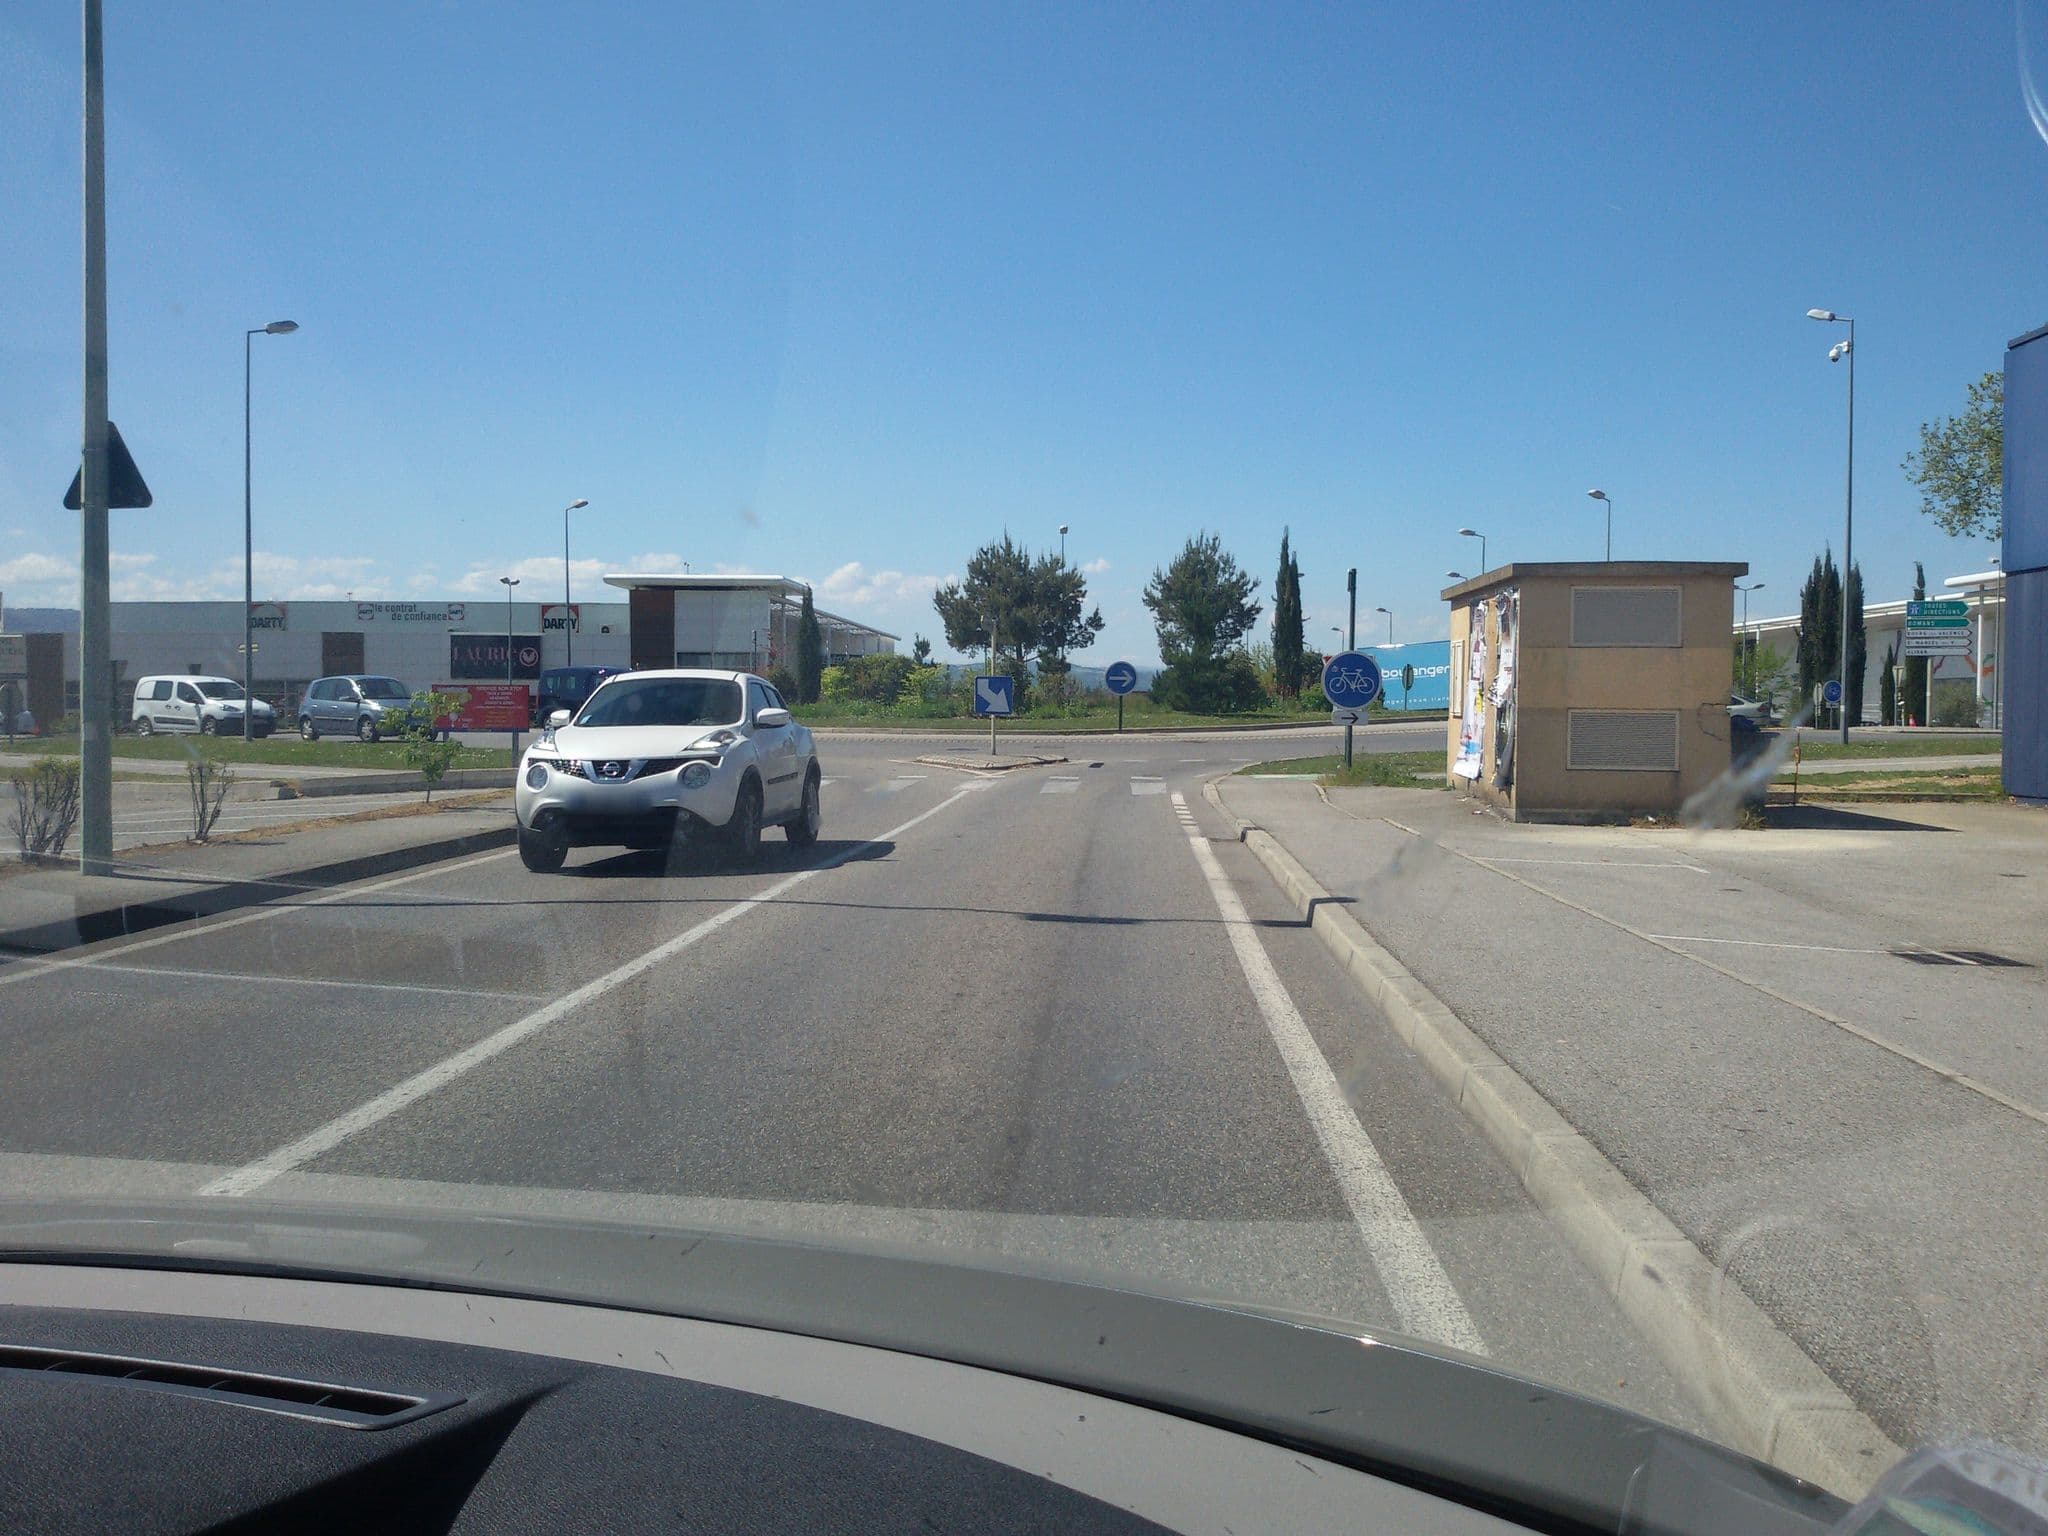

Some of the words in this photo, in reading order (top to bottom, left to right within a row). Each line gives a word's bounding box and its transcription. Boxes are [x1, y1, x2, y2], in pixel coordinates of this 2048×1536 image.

[384, 603, 416, 613] contrat
[391, 611, 402, 621] de
[405, 611, 448, 621] confiance
[251, 617, 284, 629] DARTY
[543, 618, 577, 630] DARTY
[1381, 665, 1449, 678] bouanger
